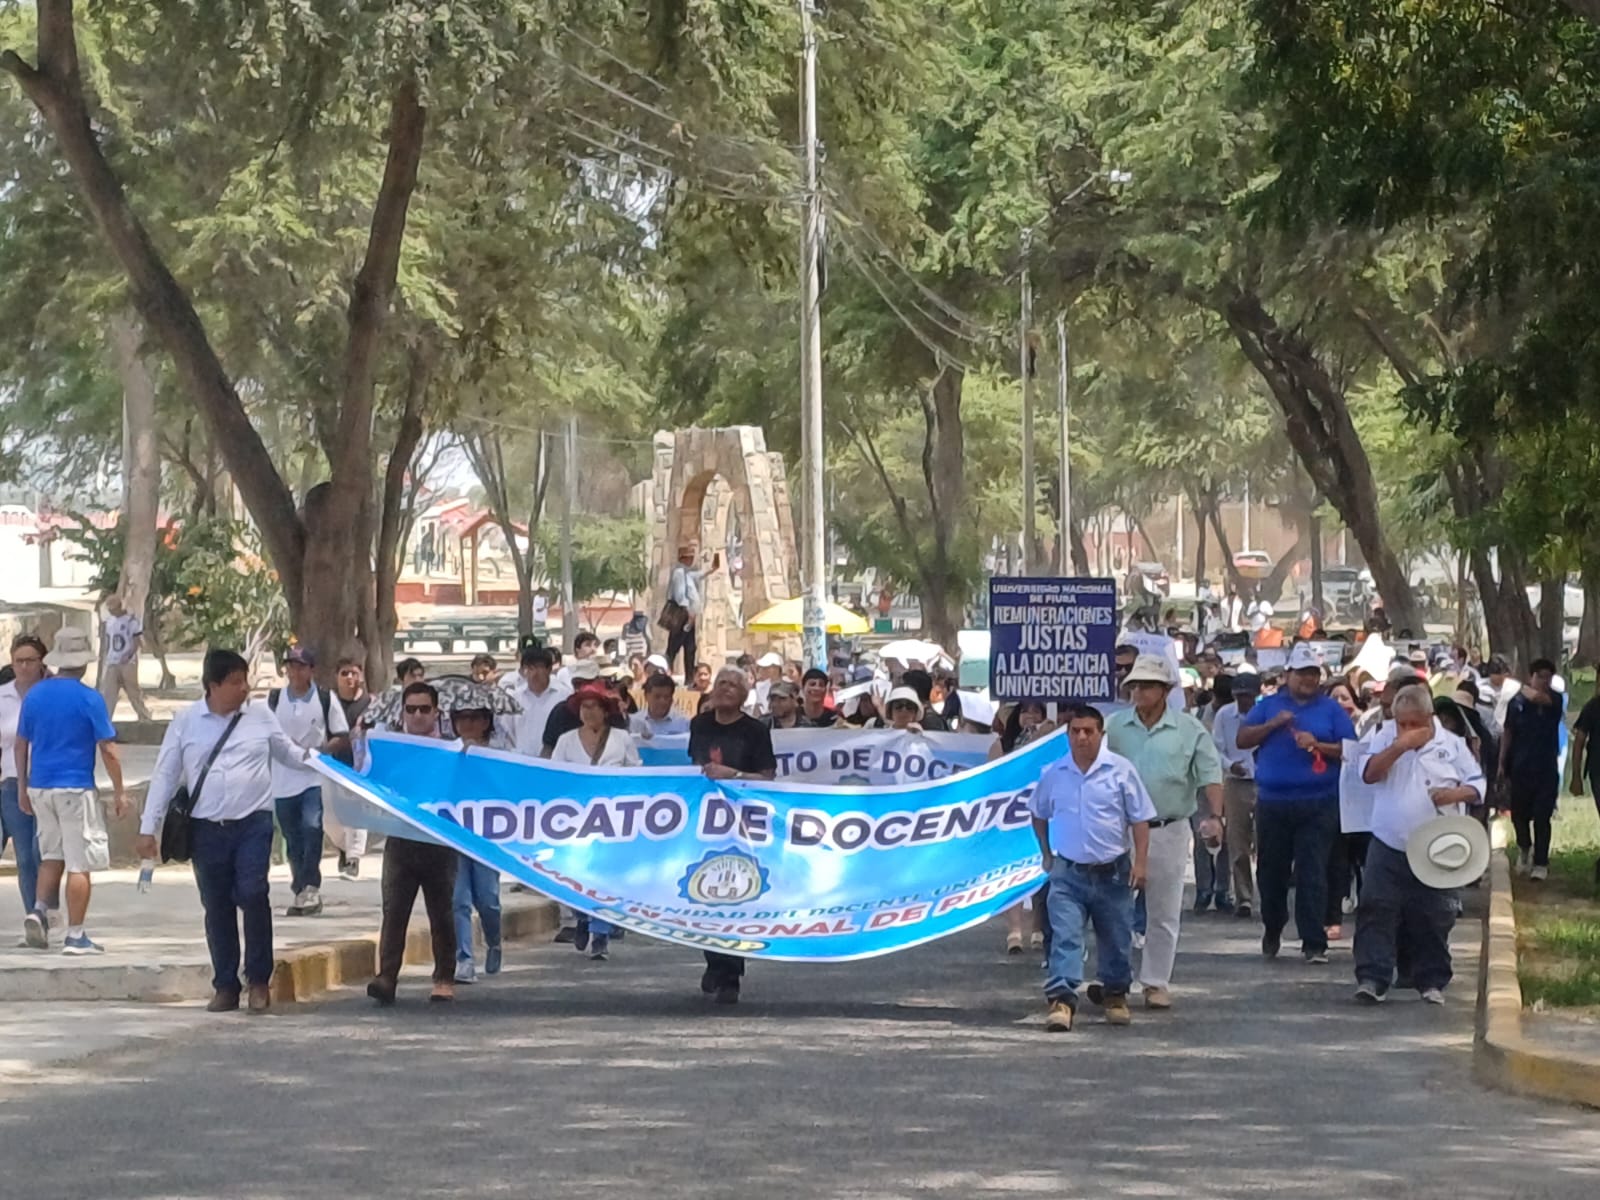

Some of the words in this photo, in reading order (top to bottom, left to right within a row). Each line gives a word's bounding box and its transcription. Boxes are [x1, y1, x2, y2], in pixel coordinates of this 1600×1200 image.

[994, 605, 1113, 625] REMUNERACIONES
[1018, 625, 1088, 651] JUSTAS
[996, 653, 1007, 674] A
[1010, 653, 1030, 674] LA
[1033, 653, 1110, 675] DOCENCIA
[995, 675, 1110, 697] UNIVERSITARIA
[831, 748, 871, 772] DE
[702, 798, 768, 841] DE
[870, 903, 927, 928] DE
[939, 867, 1041, 913] PIUR
